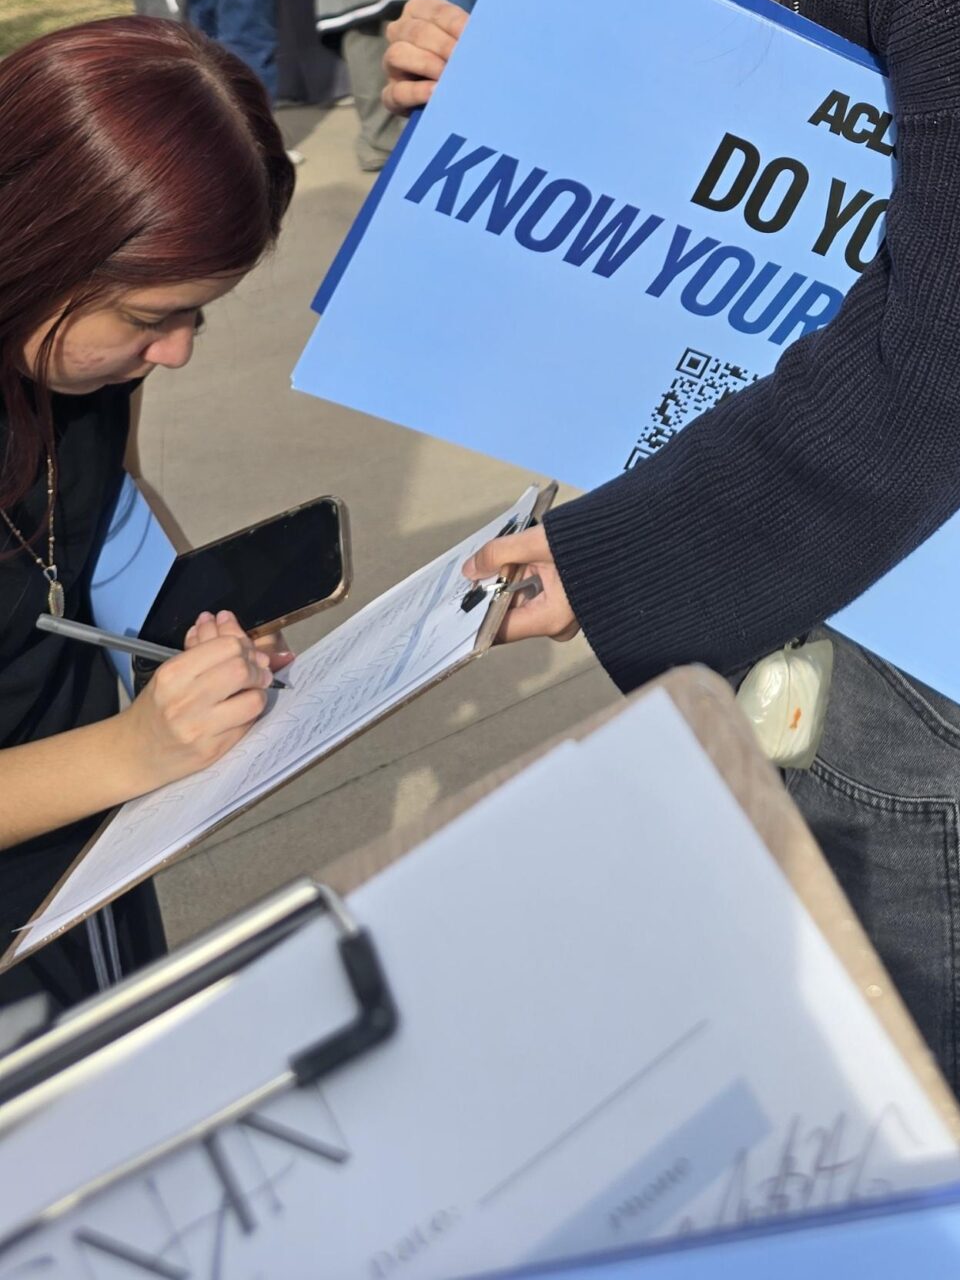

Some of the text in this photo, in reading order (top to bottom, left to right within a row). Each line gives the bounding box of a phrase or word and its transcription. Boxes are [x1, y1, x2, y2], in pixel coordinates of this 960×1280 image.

[807, 89, 897, 158] ACL
[403, 132, 665, 279] KNOW
[644, 224, 845, 346] YOUR
[690, 132, 890, 274] DO YO
